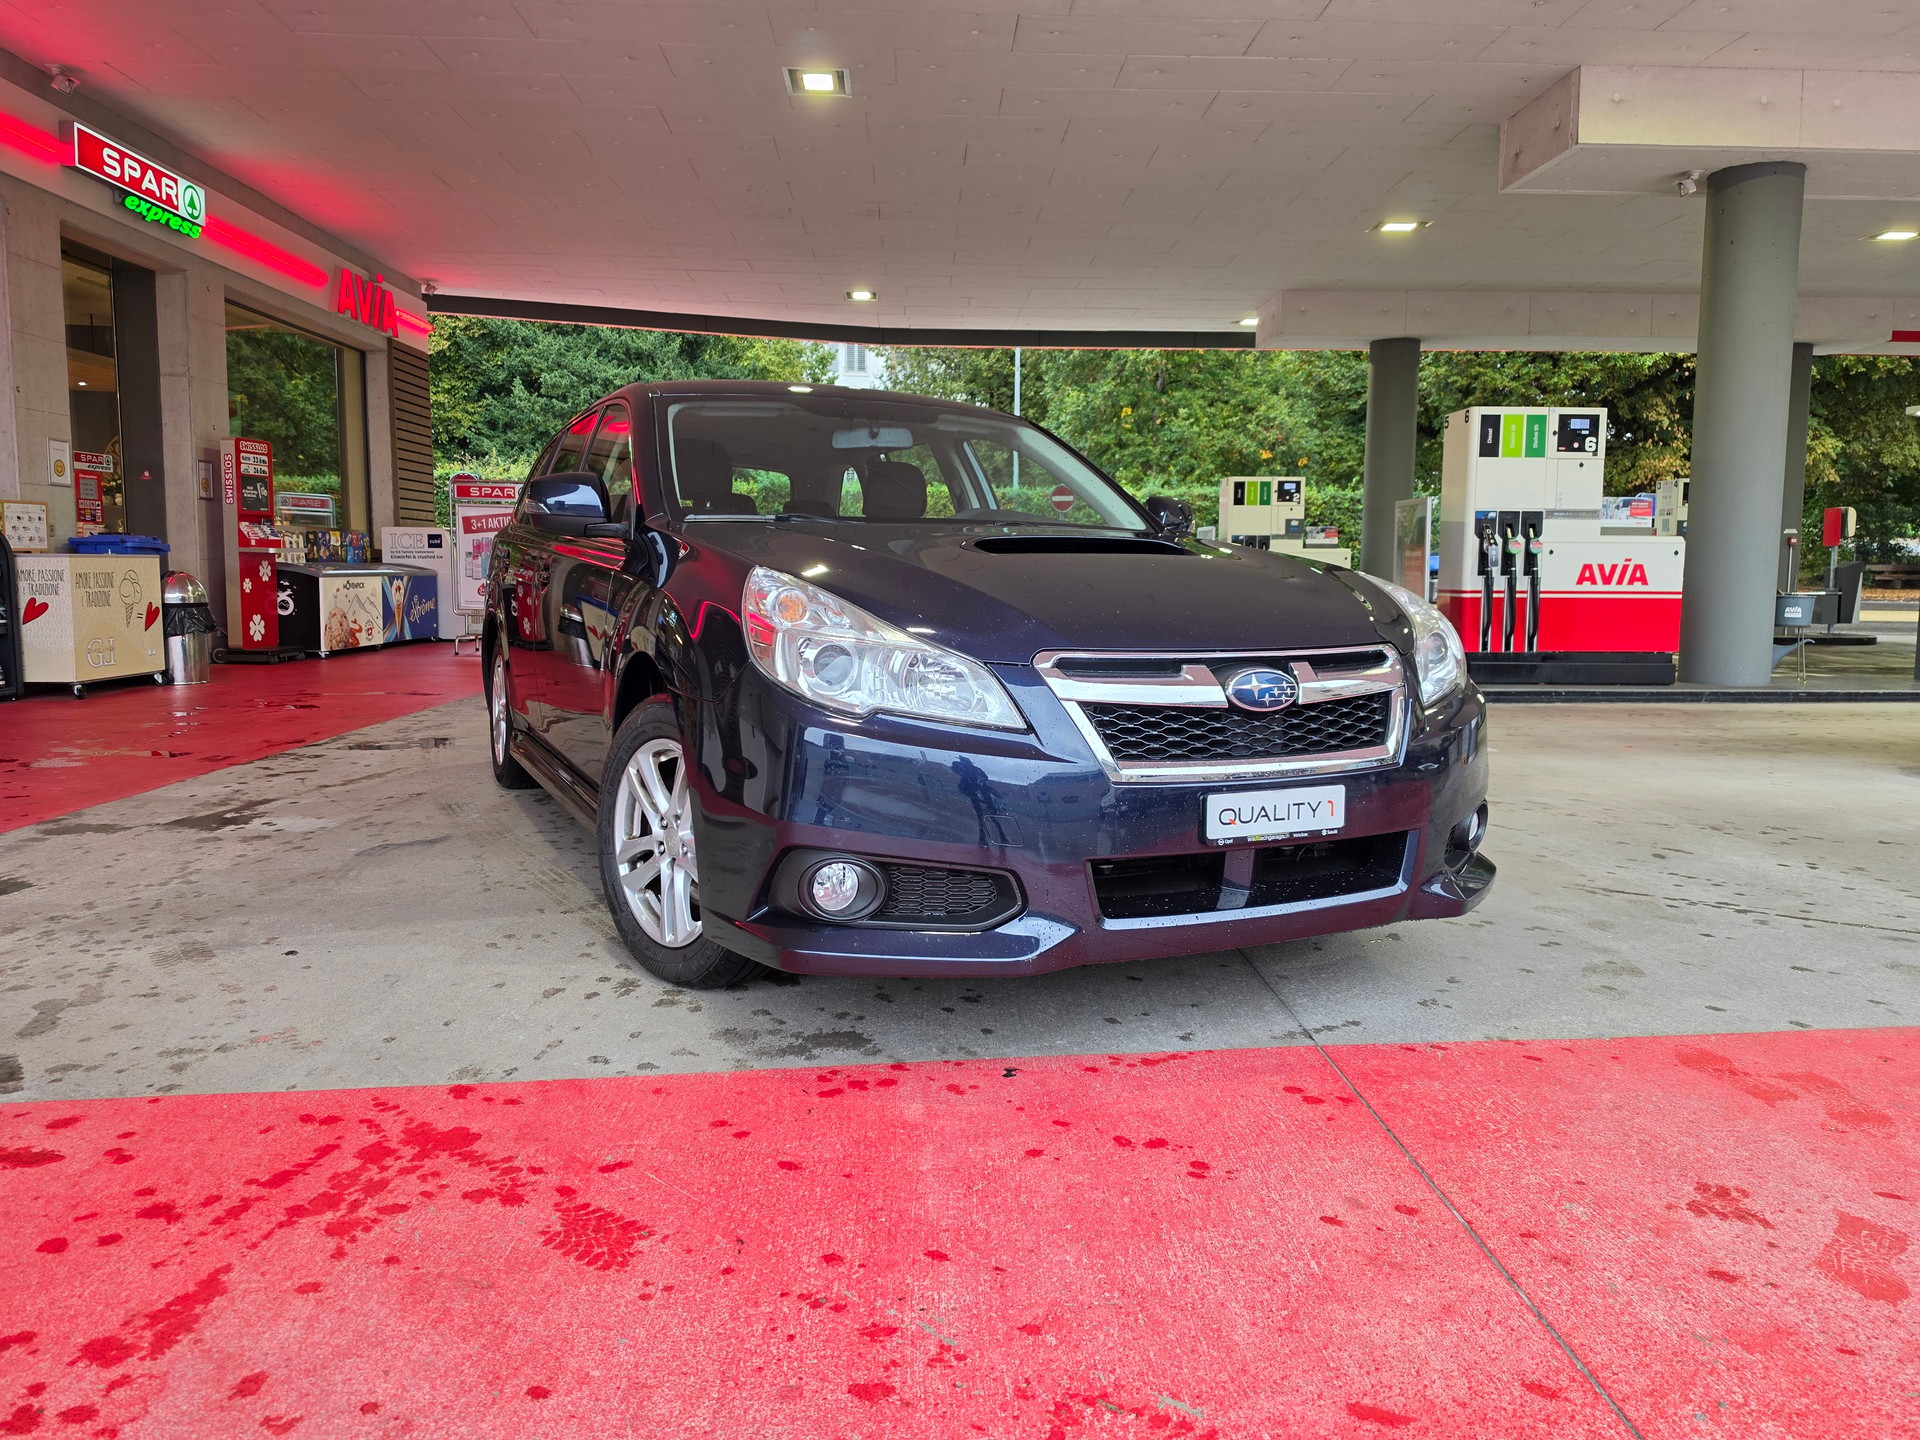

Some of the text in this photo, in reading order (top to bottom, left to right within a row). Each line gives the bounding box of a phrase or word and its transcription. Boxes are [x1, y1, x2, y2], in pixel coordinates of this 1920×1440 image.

[102, 147, 178, 206] SPAR
[124, 195, 201, 239] express
[338, 267, 399, 338] AVIA
[1444, 416, 1450, 429] 5
[1464, 410, 1470, 423] 6
[240, 441, 268, 453] SWISSLOS
[1584, 436, 1597, 452] 6
[80, 454, 104, 463] SPAR
[225, 454, 235, 504] SWISSLOS
[1673, 480, 1678, 488] 4
[470, 487, 515, 497] SPAR
[1293, 493, 1300, 502] 2
[470, 518, 486, 530] 3+1
[390, 533, 425, 549] ICE
[17, 569, 65, 582] AMORE PASSIONE
[1575, 558, 1649, 586] AVIA
[75, 571, 115, 589] AMORE PASSIONE
[28, 583, 60, 596] TRADIZIONE
[85, 590, 111, 607] TRADIZIONE
[1219, 800, 1334, 826] QUALITY 1
